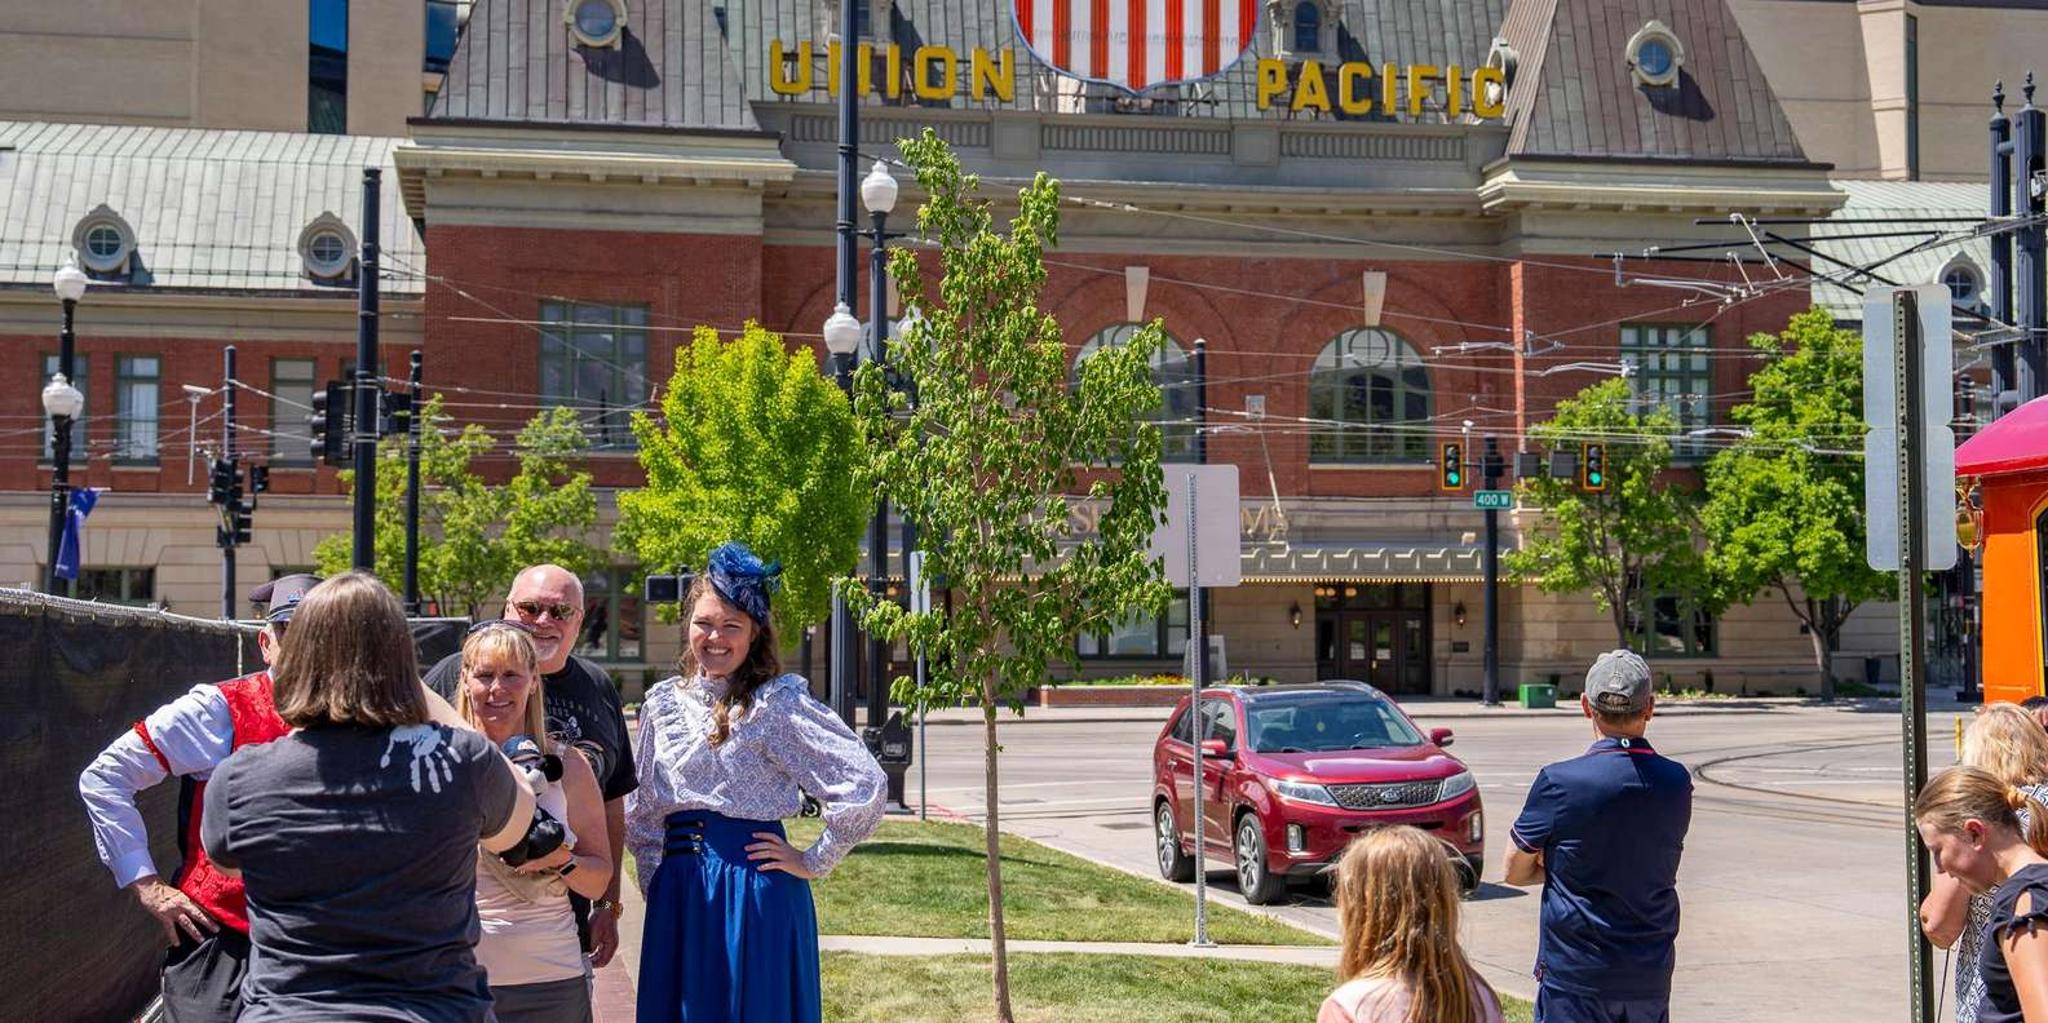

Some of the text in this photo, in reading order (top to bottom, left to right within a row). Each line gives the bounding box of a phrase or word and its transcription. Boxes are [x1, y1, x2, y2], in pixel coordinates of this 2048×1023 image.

[1256, 58, 1504, 118] PACIFIC
[1478, 494, 1509, 505] 400 W
